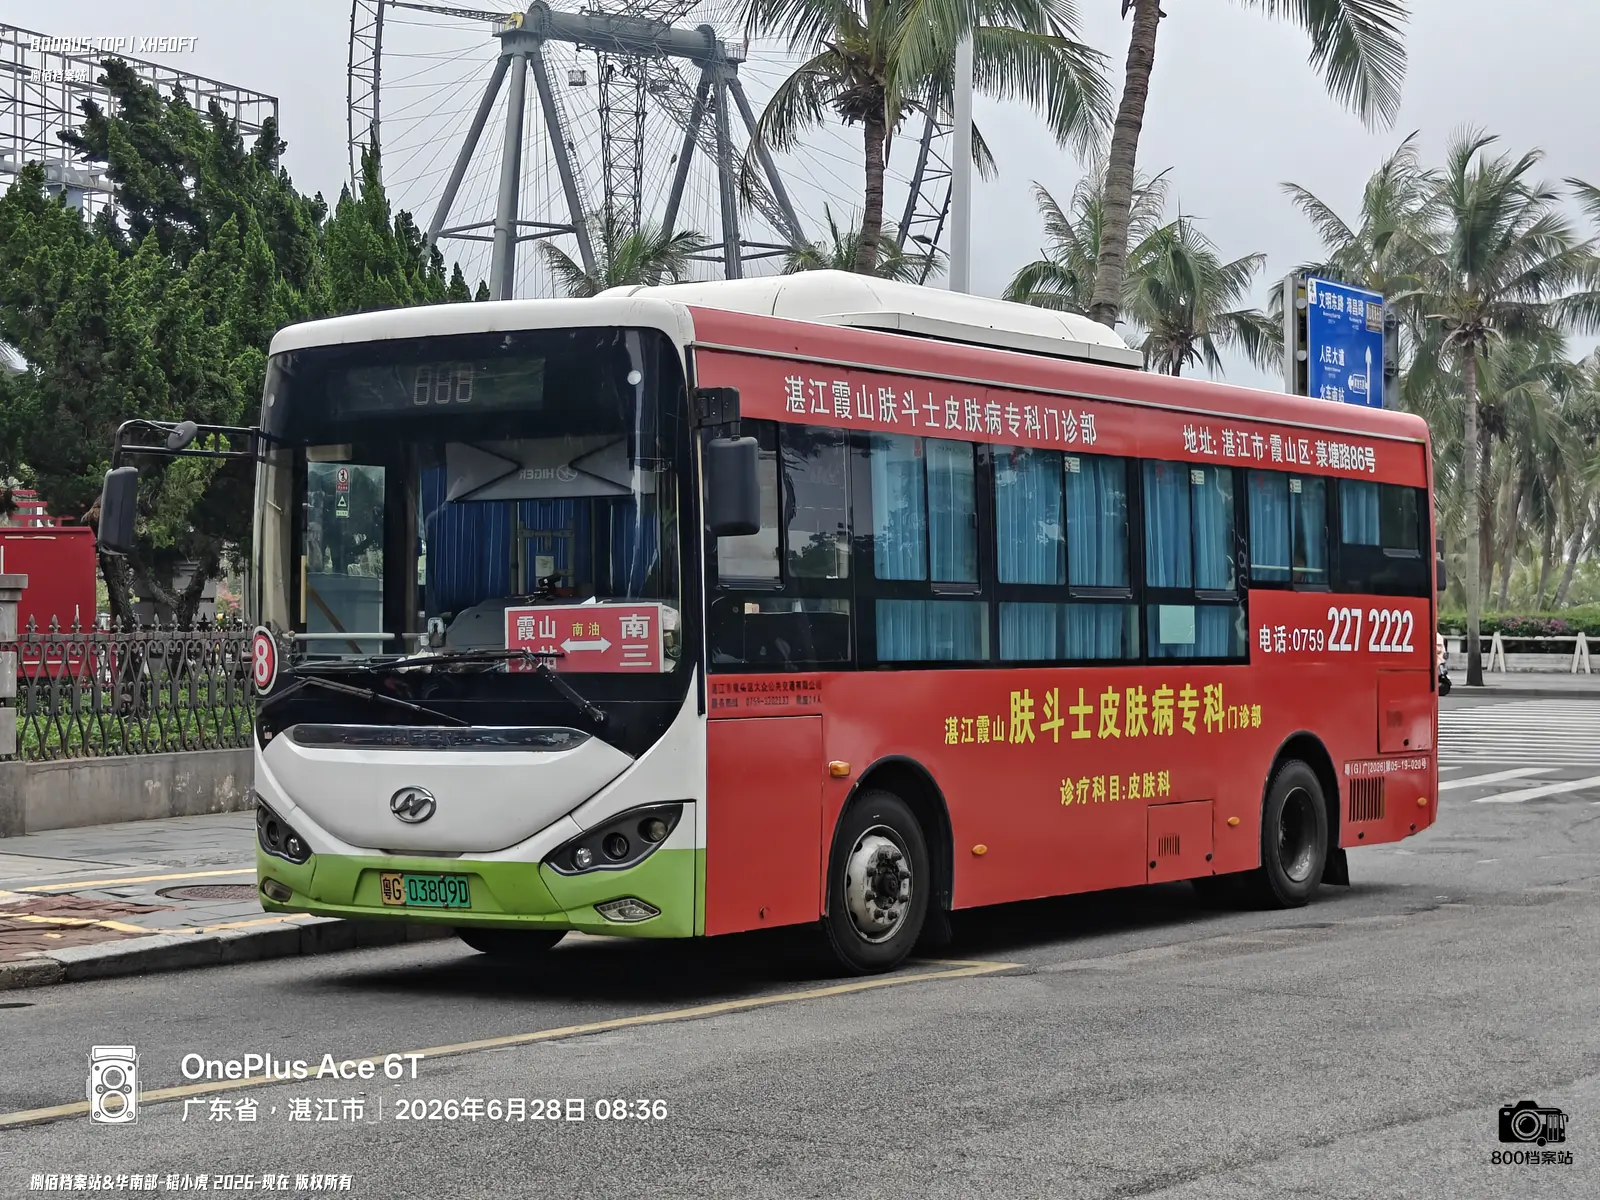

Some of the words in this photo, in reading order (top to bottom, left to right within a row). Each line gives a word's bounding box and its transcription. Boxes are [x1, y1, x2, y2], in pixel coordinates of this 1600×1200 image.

[1319, 345, 1345, 367] 人民大道
[784, 375, 1097, 446] 湛江霞山肤斗士皮肤病专科门诊部
[516, 615, 556, 641] 霞山
[572, 621, 600, 637] 南油
[1327, 606, 1362, 651] 227
[1368, 608, 1414, 653] 2222
[255, 639, 268, 682] 8
[1060, 770, 1171, 806] 诊疗科目:皮肤科
